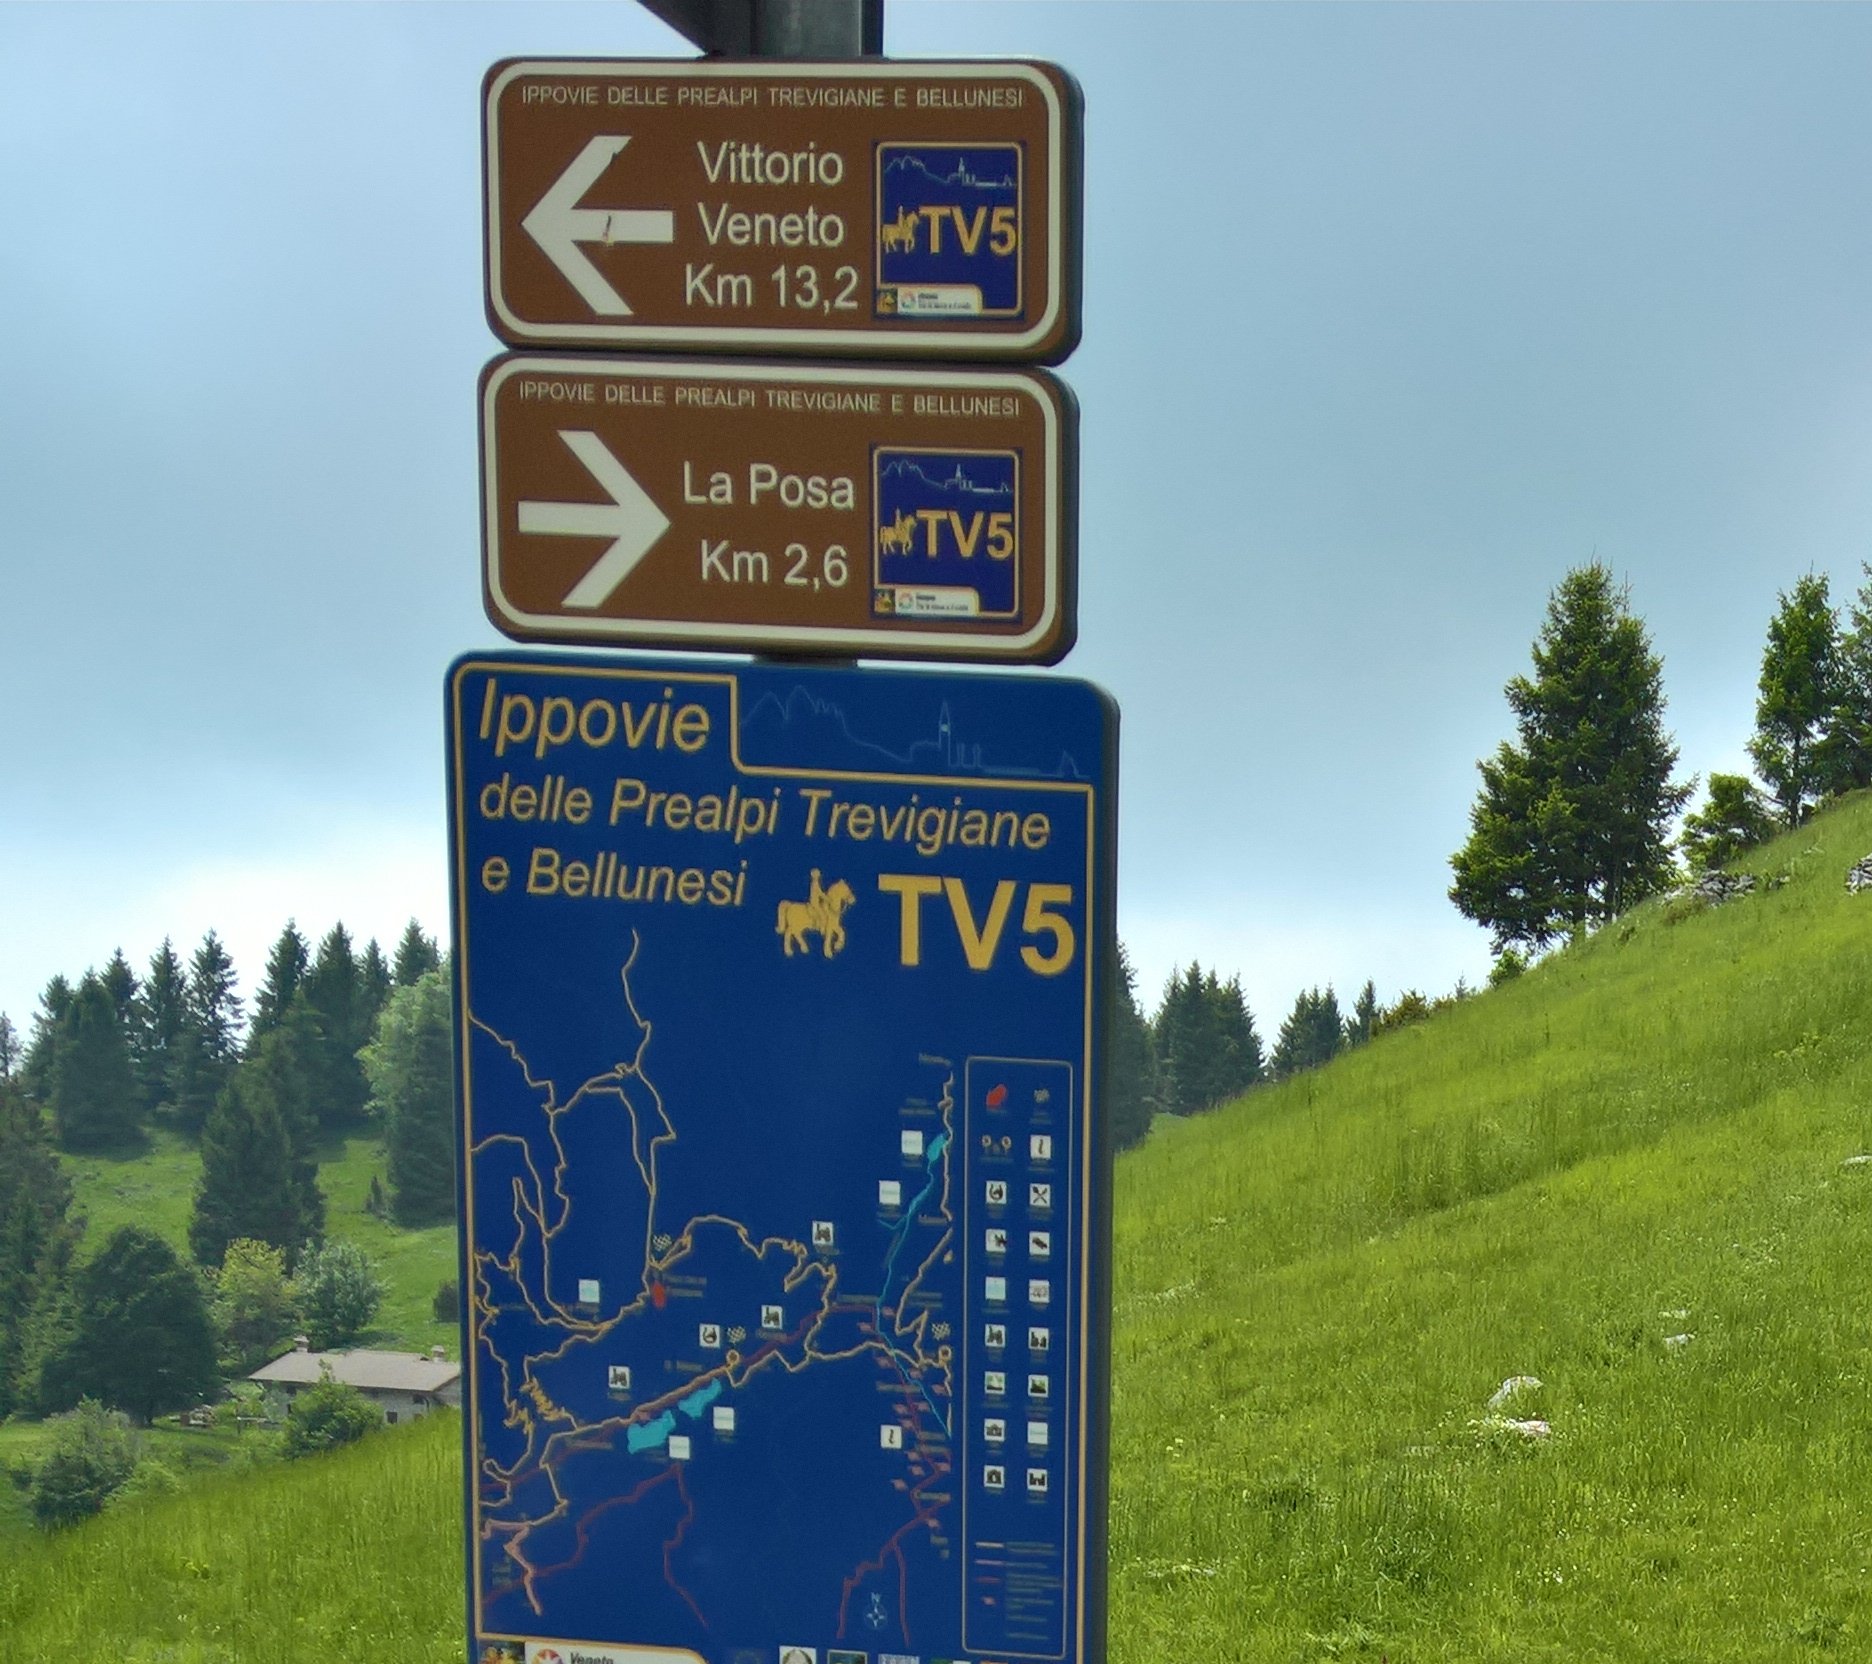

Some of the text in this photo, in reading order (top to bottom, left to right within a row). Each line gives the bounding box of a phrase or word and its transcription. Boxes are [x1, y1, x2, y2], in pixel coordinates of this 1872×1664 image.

[522, 85, 1023, 109] IPPOVIE DELLE PREALPI TREVIGIANE E BELLUNESI
[697, 141, 843, 186] Vittorio
[697, 202, 845, 248] Veneto
[919, 206, 1018, 256] TV5
[687, 265, 859, 312] Km 13,2
[519, 381, 1019, 416] IPPOVIE DELLE PREALPI TREVIGIANE E BELLUNESI
[683, 461, 855, 510] La Posa
[917, 509, 1014, 559] TV5
[701, 540, 848, 590] Km 2,6
[480, 678, 710, 759] Ippovie
[480, 774, 1050, 855] delle Prealpi Trevigiane
[481, 846, 747, 907] e Bellunesi
[878, 874, 1074, 976] TV5
